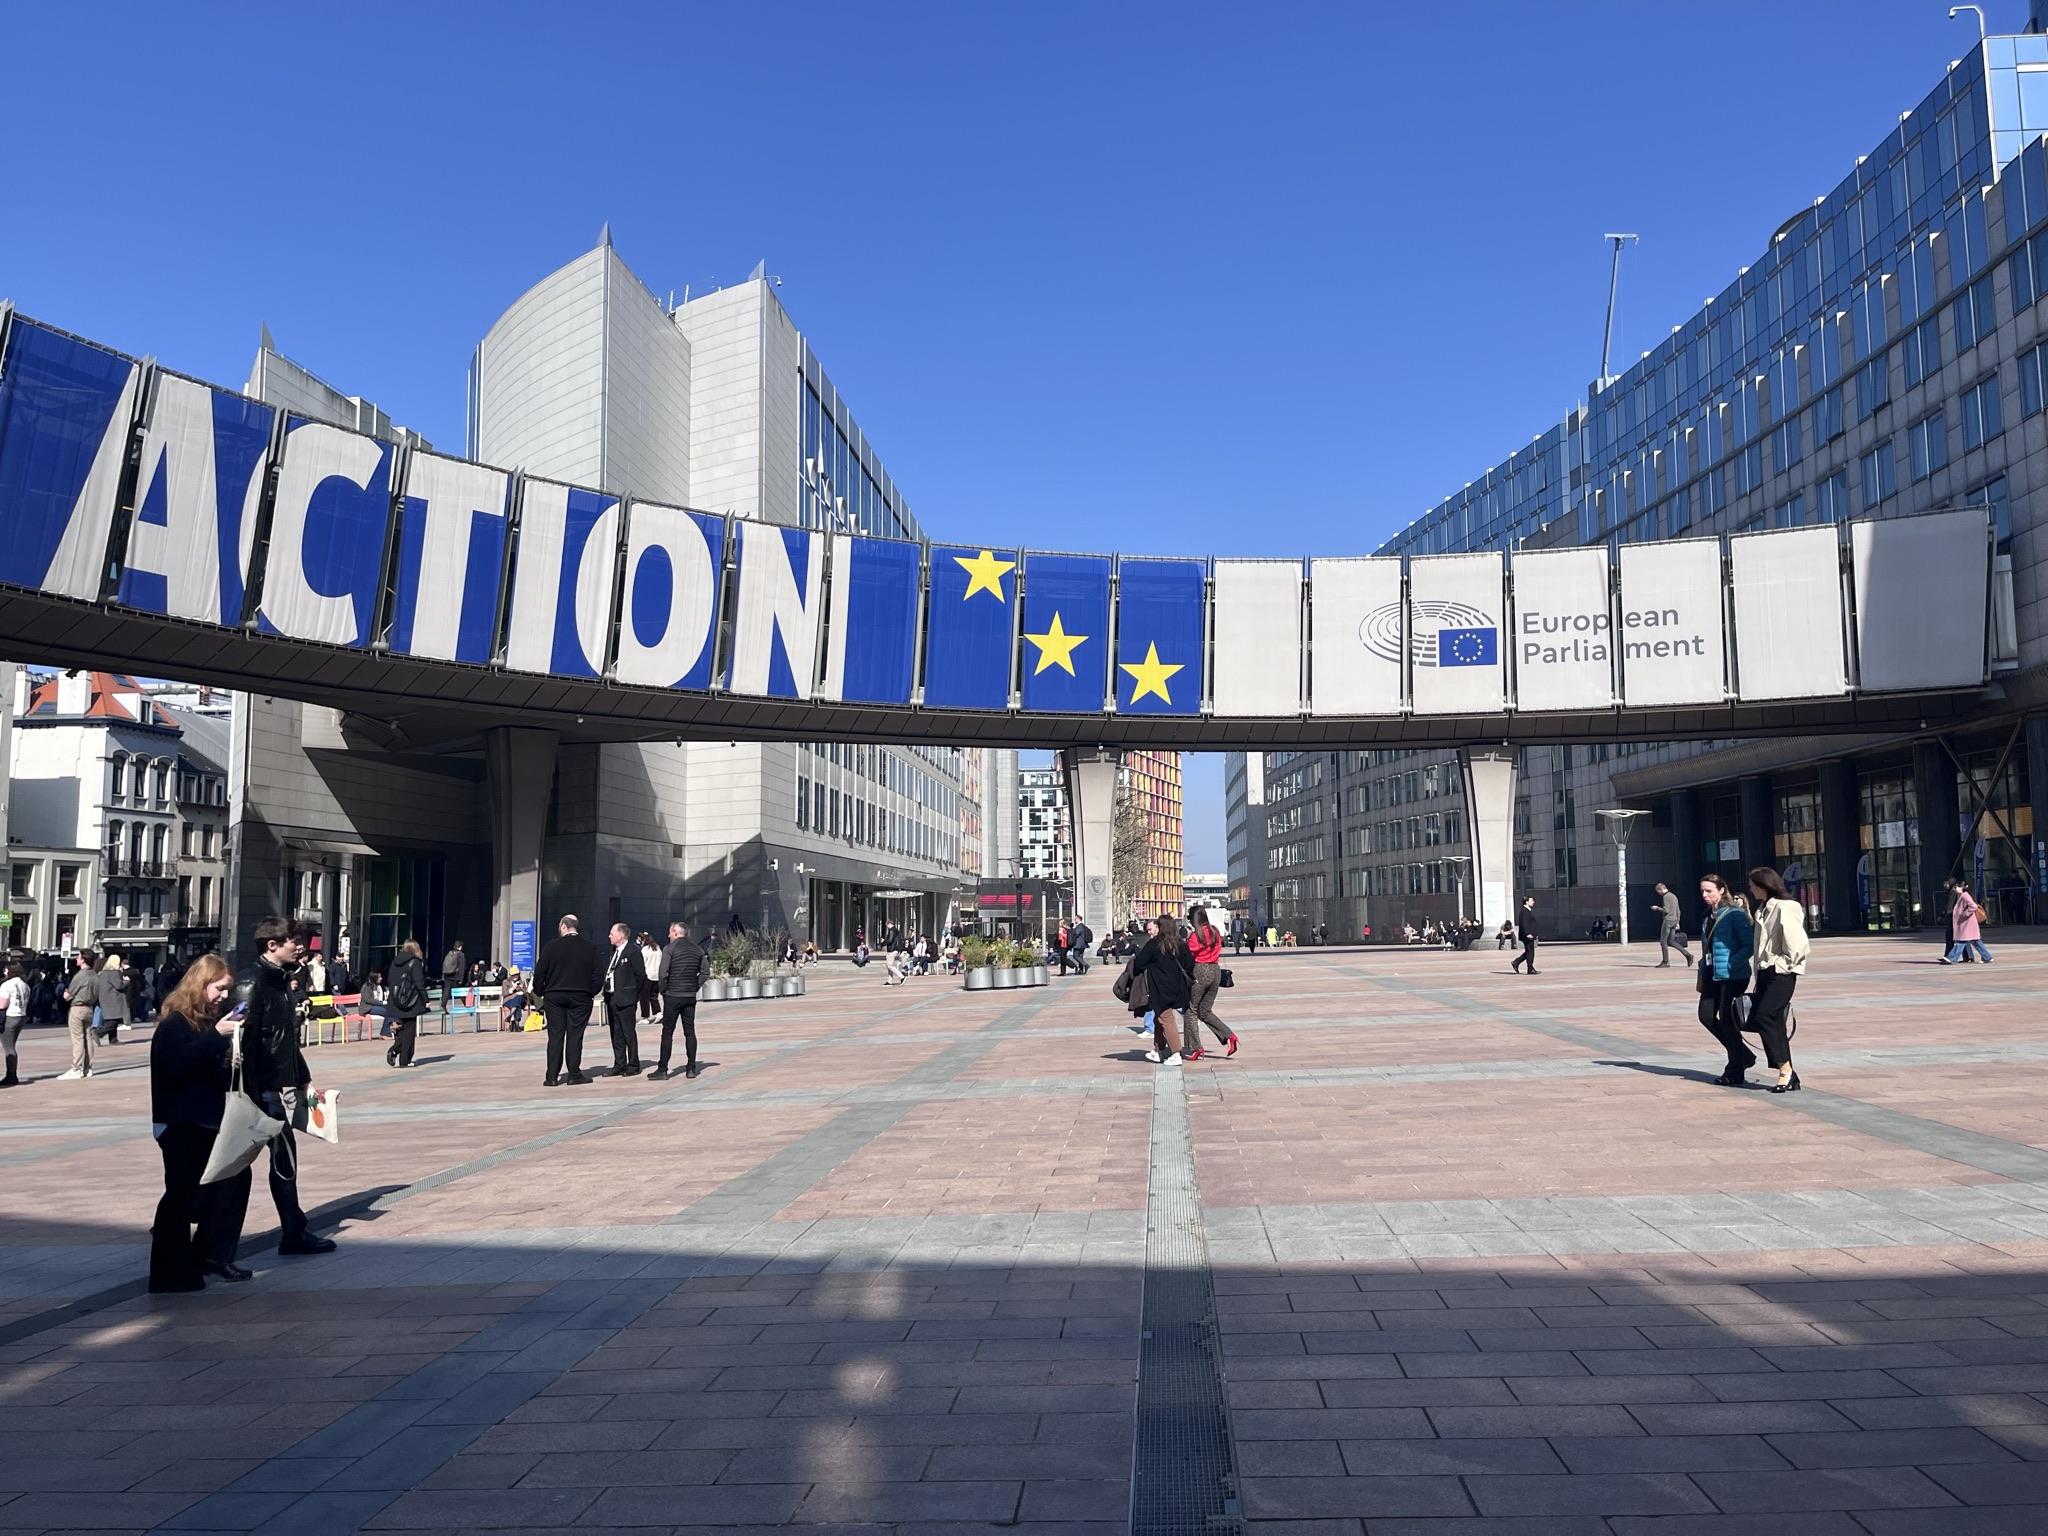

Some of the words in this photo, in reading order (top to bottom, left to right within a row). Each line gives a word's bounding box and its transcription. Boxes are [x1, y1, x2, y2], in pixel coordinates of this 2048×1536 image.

[42, 363, 851, 701] ACTION
[1522, 608, 1679, 635] European
[1523, 635, 1704, 665] Parliament
